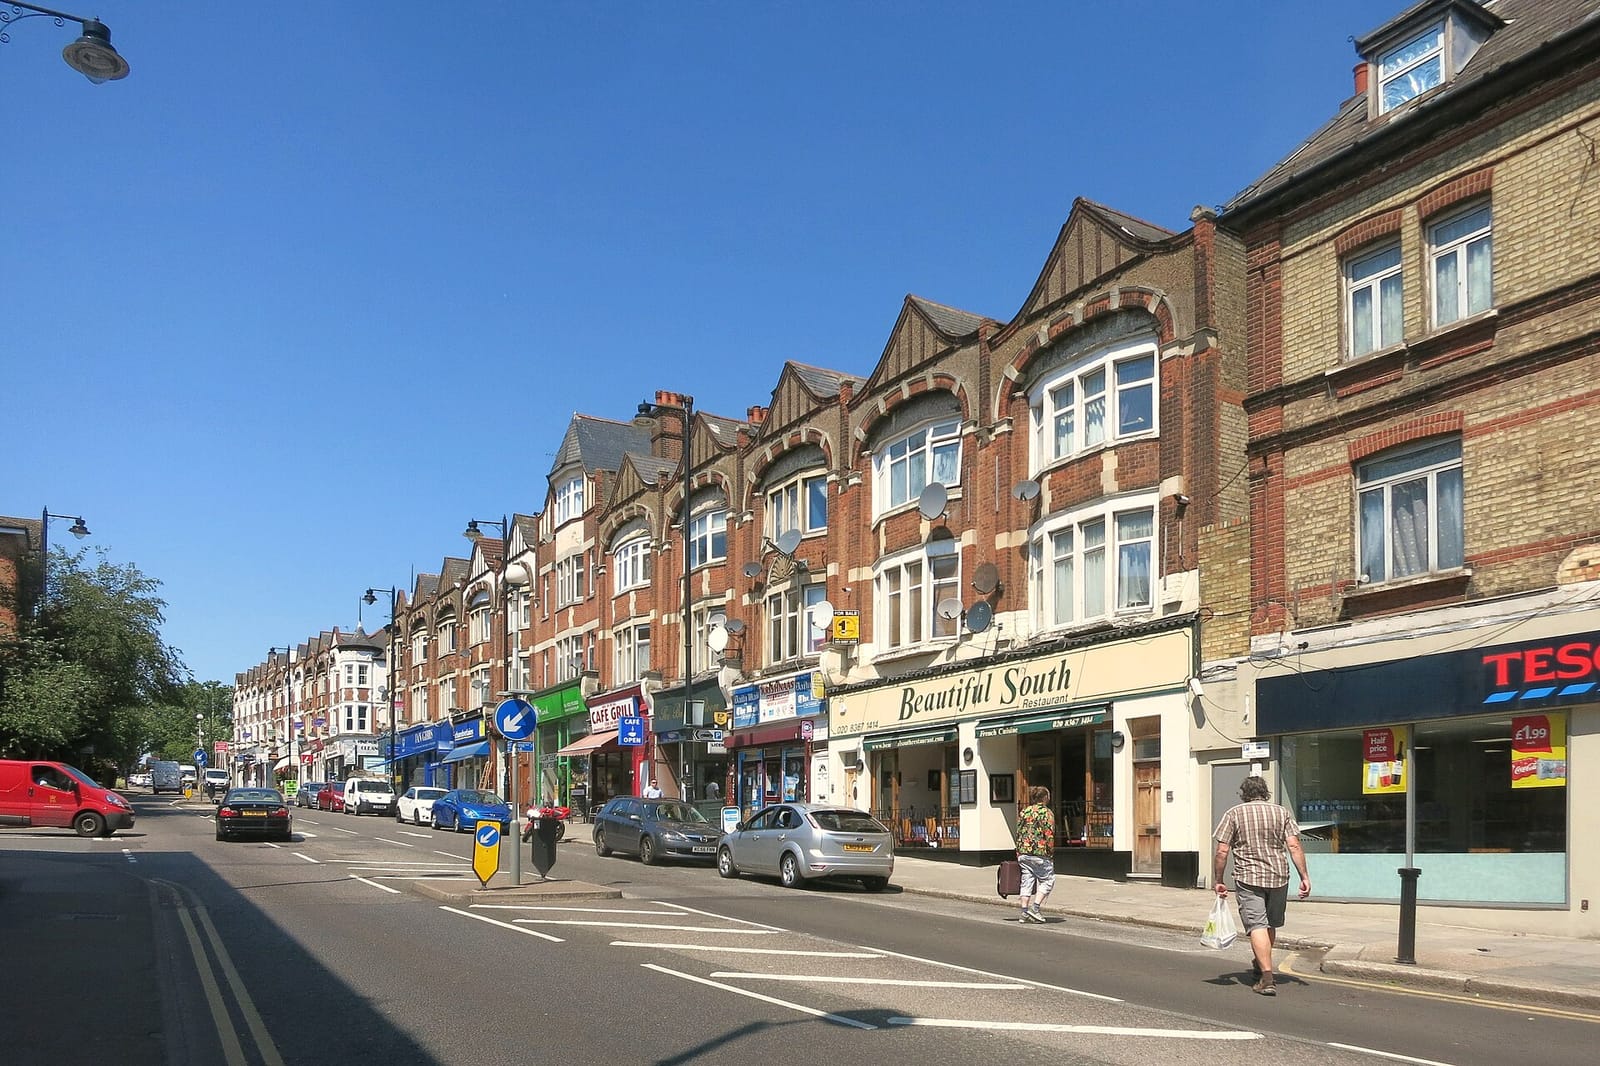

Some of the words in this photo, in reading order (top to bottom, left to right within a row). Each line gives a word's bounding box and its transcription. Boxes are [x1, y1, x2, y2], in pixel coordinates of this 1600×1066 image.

[1483, 642, 1600, 686] TES
[899, 673, 993, 721] Beautiful
[1000, 659, 1071, 705] South
[1022, 694, 1068, 709] Restaurant
[592, 709, 609, 724] CAFE
[611, 704, 633, 720] GRILL
[836, 726, 848, 734] 020
[849, 722, 865, 732] 8367
[866, 721, 879, 729] 1414
[1052, 719, 1063, 728] 020
[979, 727, 997, 738] French
[998, 726, 1019, 736] Cuisine
[1515, 725, 1547, 740] £1.99
[1371, 737, 1387, 745] Half
[1370, 745, 1388, 754] price
